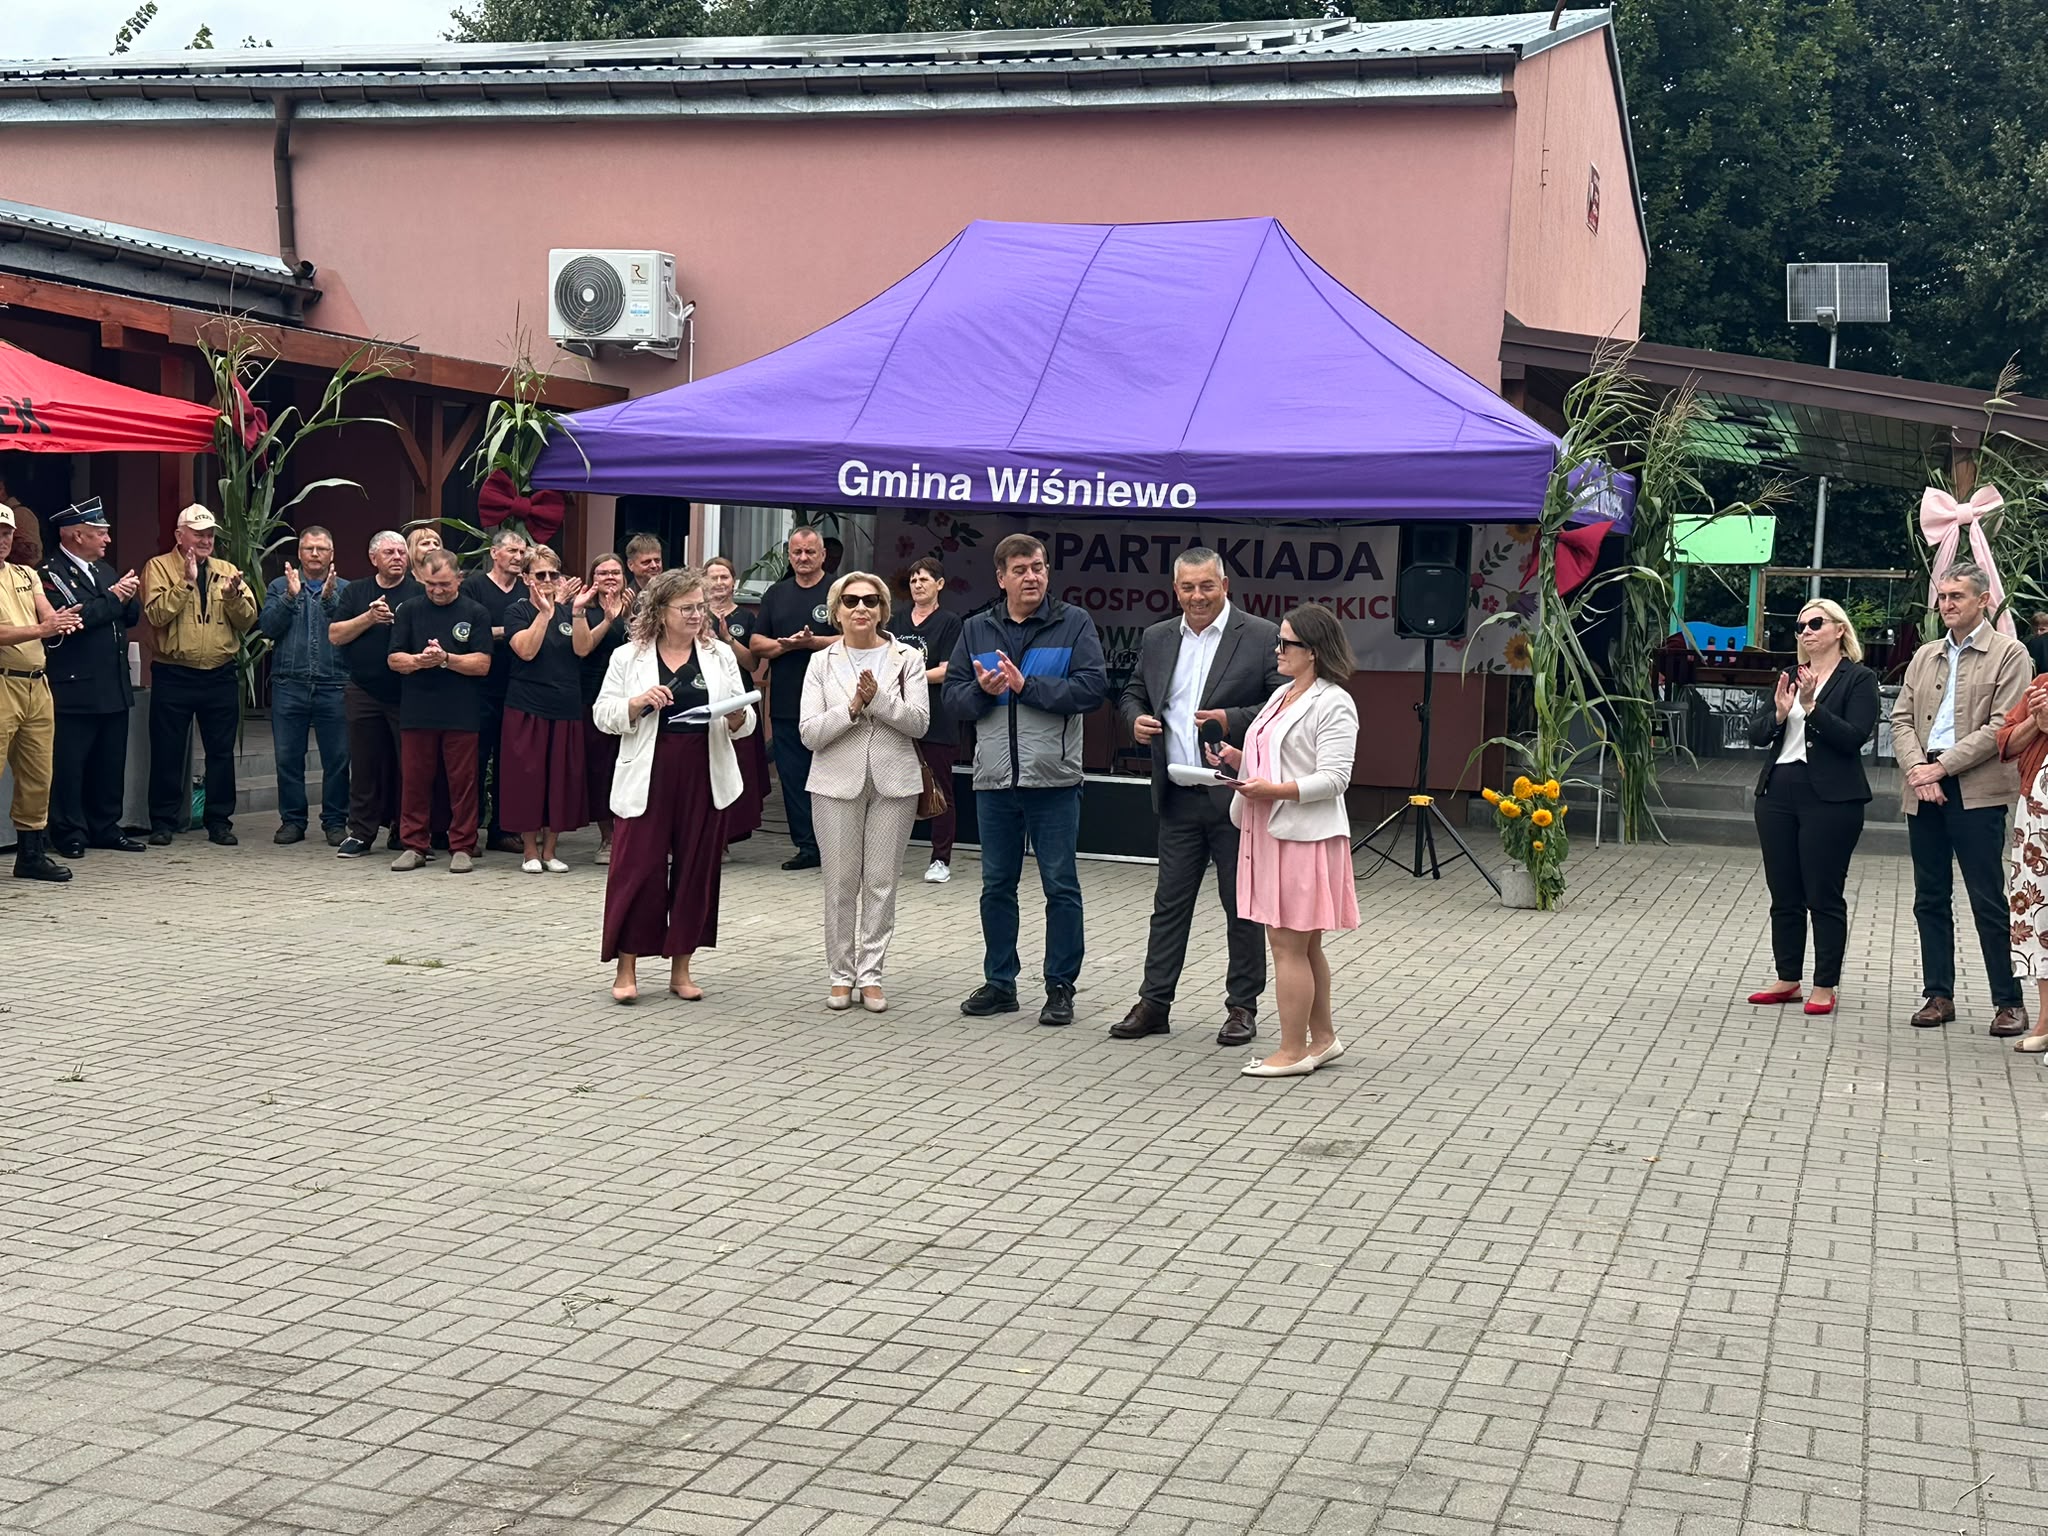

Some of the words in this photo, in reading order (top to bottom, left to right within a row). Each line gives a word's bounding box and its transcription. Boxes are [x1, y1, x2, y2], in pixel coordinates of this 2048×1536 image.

[837, 459, 973, 502] Gmina
[986, 465, 1198, 509] Wiśniewo
[1028, 530, 1385, 582] PARTKIADA
